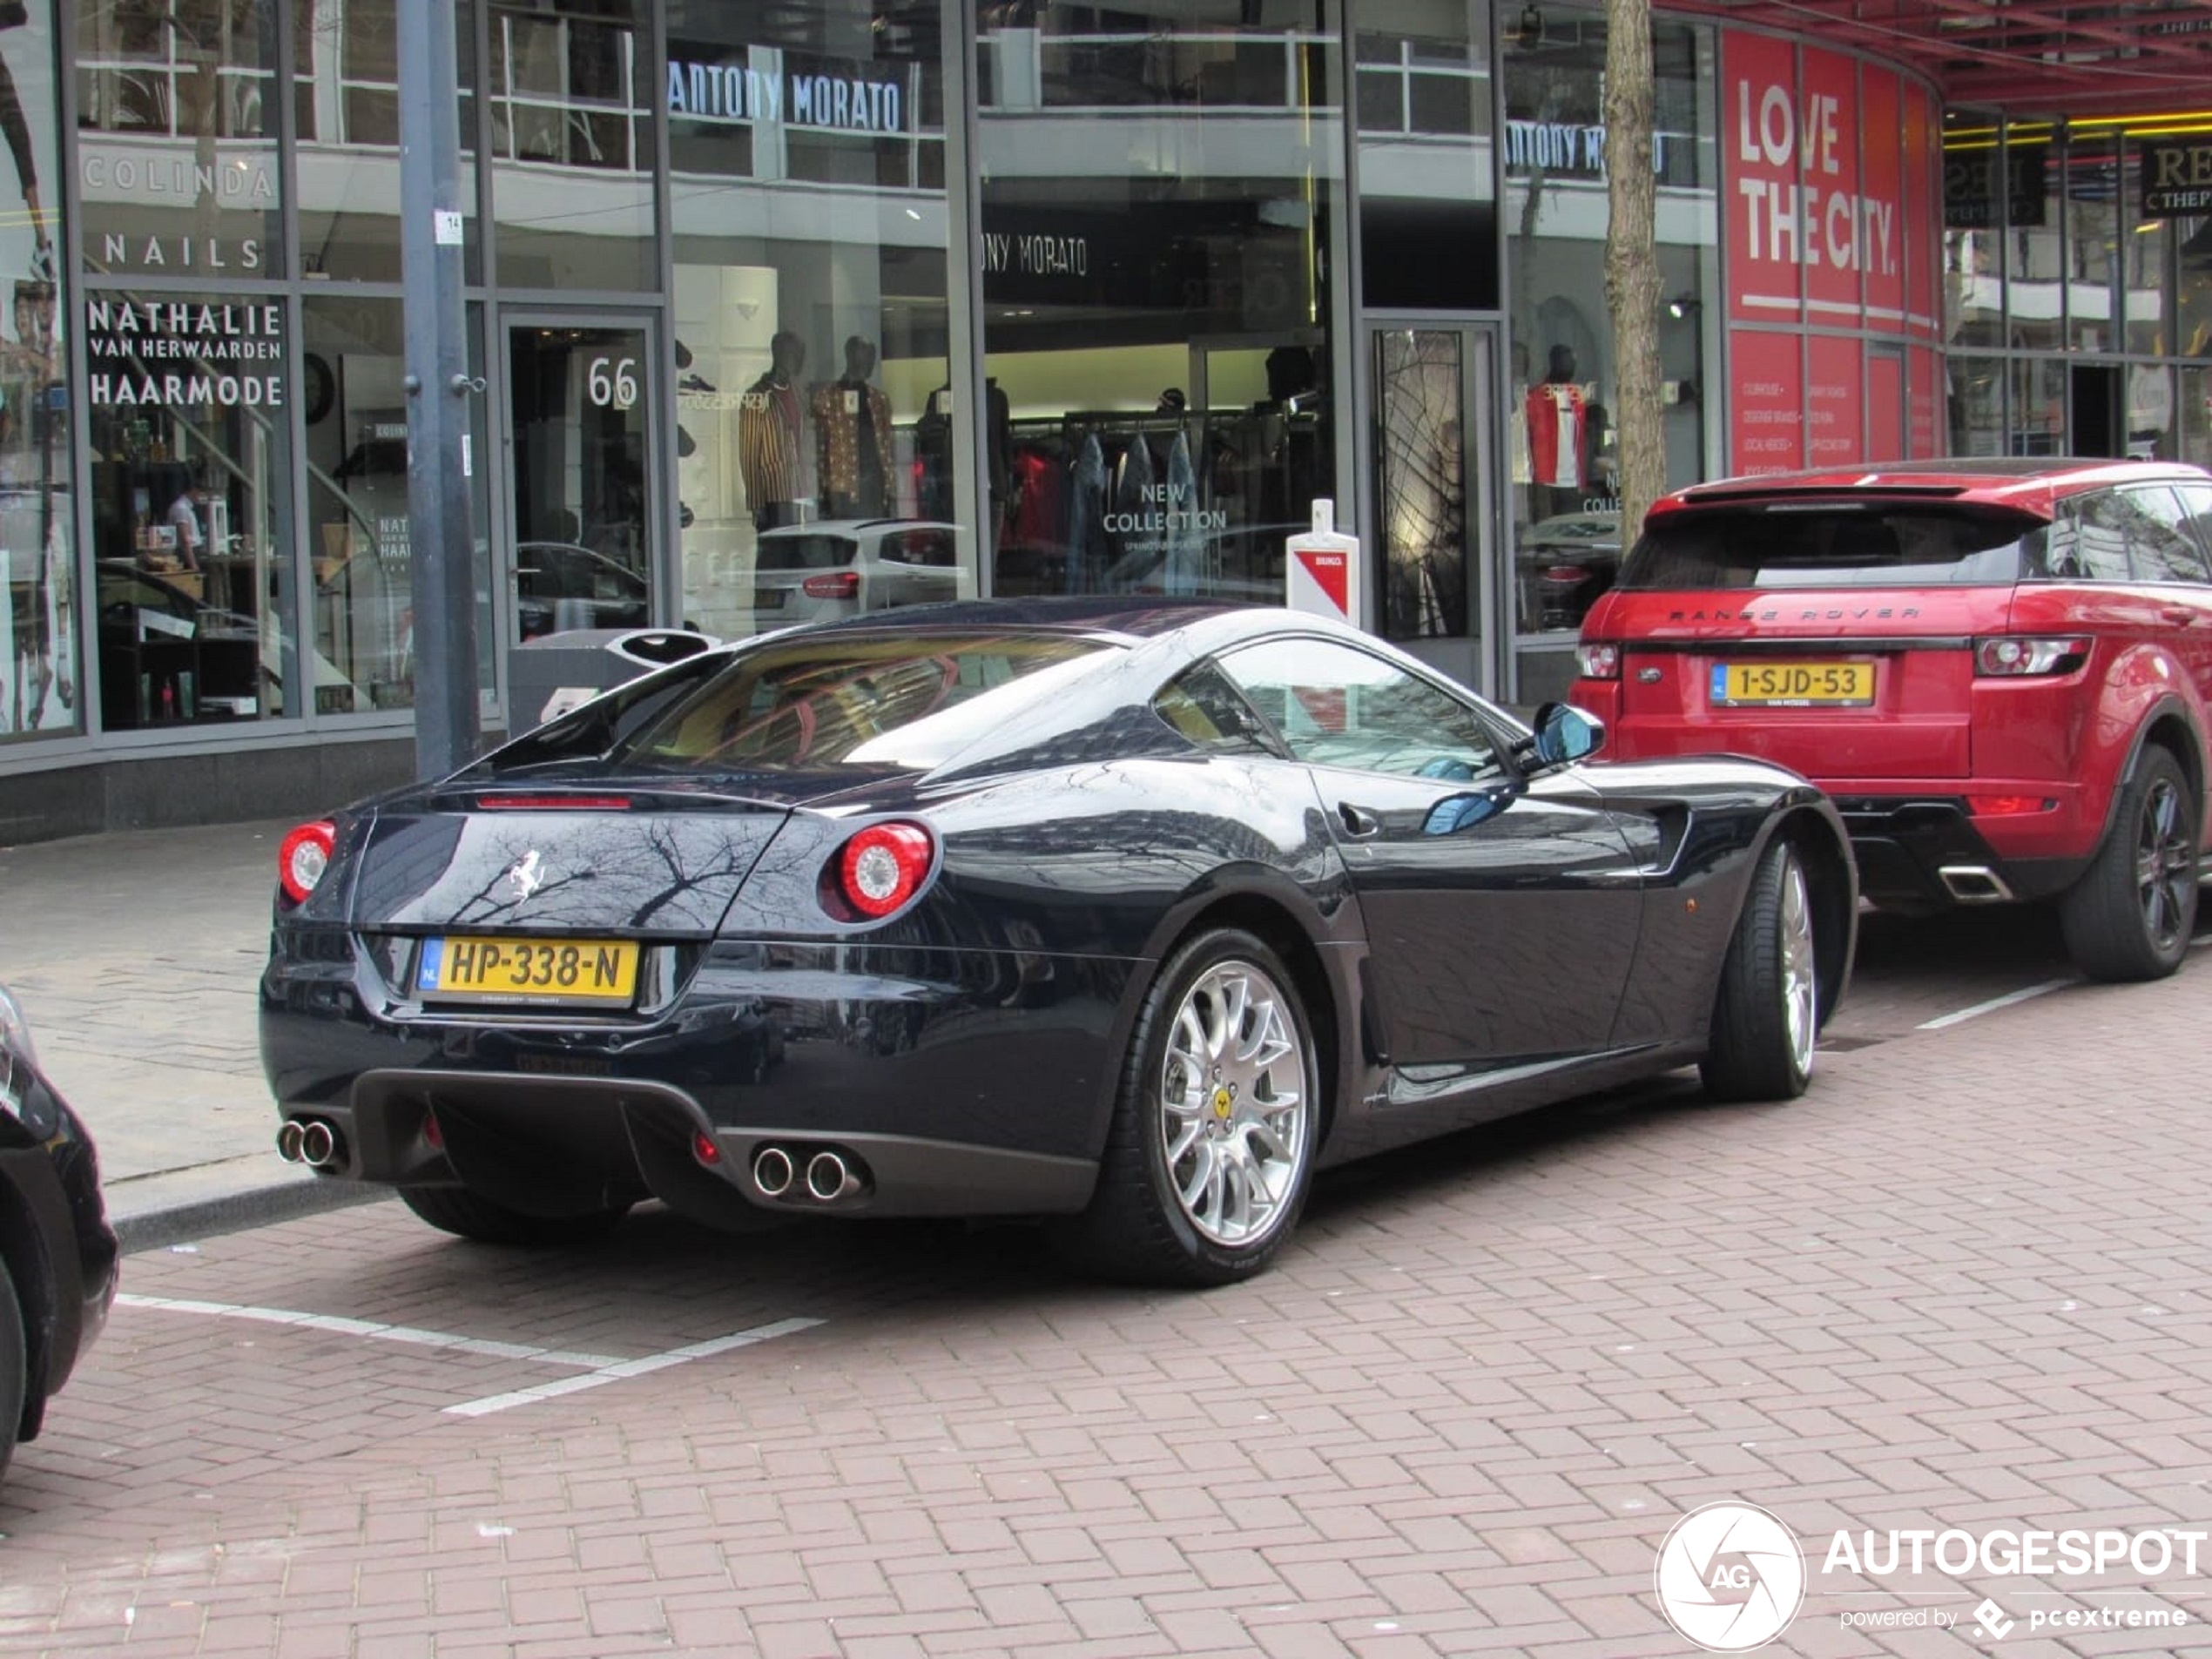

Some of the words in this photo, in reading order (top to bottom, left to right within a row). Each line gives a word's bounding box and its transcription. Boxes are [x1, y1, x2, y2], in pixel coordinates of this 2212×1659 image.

[792, 74, 899, 132] MORATO
[1739, 79, 1838, 175] LOVE
[85, 156, 274, 197] COLINDA
[1739, 178, 1820, 266] THE
[105, 233, 260, 268] NAILS
[1018, 234, 1086, 276] MORATO
[89, 300, 280, 334] NATHALIE
[91, 338, 133, 357] VAN
[142, 340, 280, 359] HERWAARDEN
[91, 374, 283, 406] HAARMODE
[590, 357, 637, 407] 66
[1141, 483, 1186, 502] NEW
[1103, 510, 1226, 532] COLLECTION
[1669, 610, 1778, 621] RANGE
[1802, 608, 1919, 620] ROVER
[1742, 669, 1857, 694] 1-SJD-53
[423, 969, 437, 981] NL
[450, 943, 620, 987] HP-338-N
